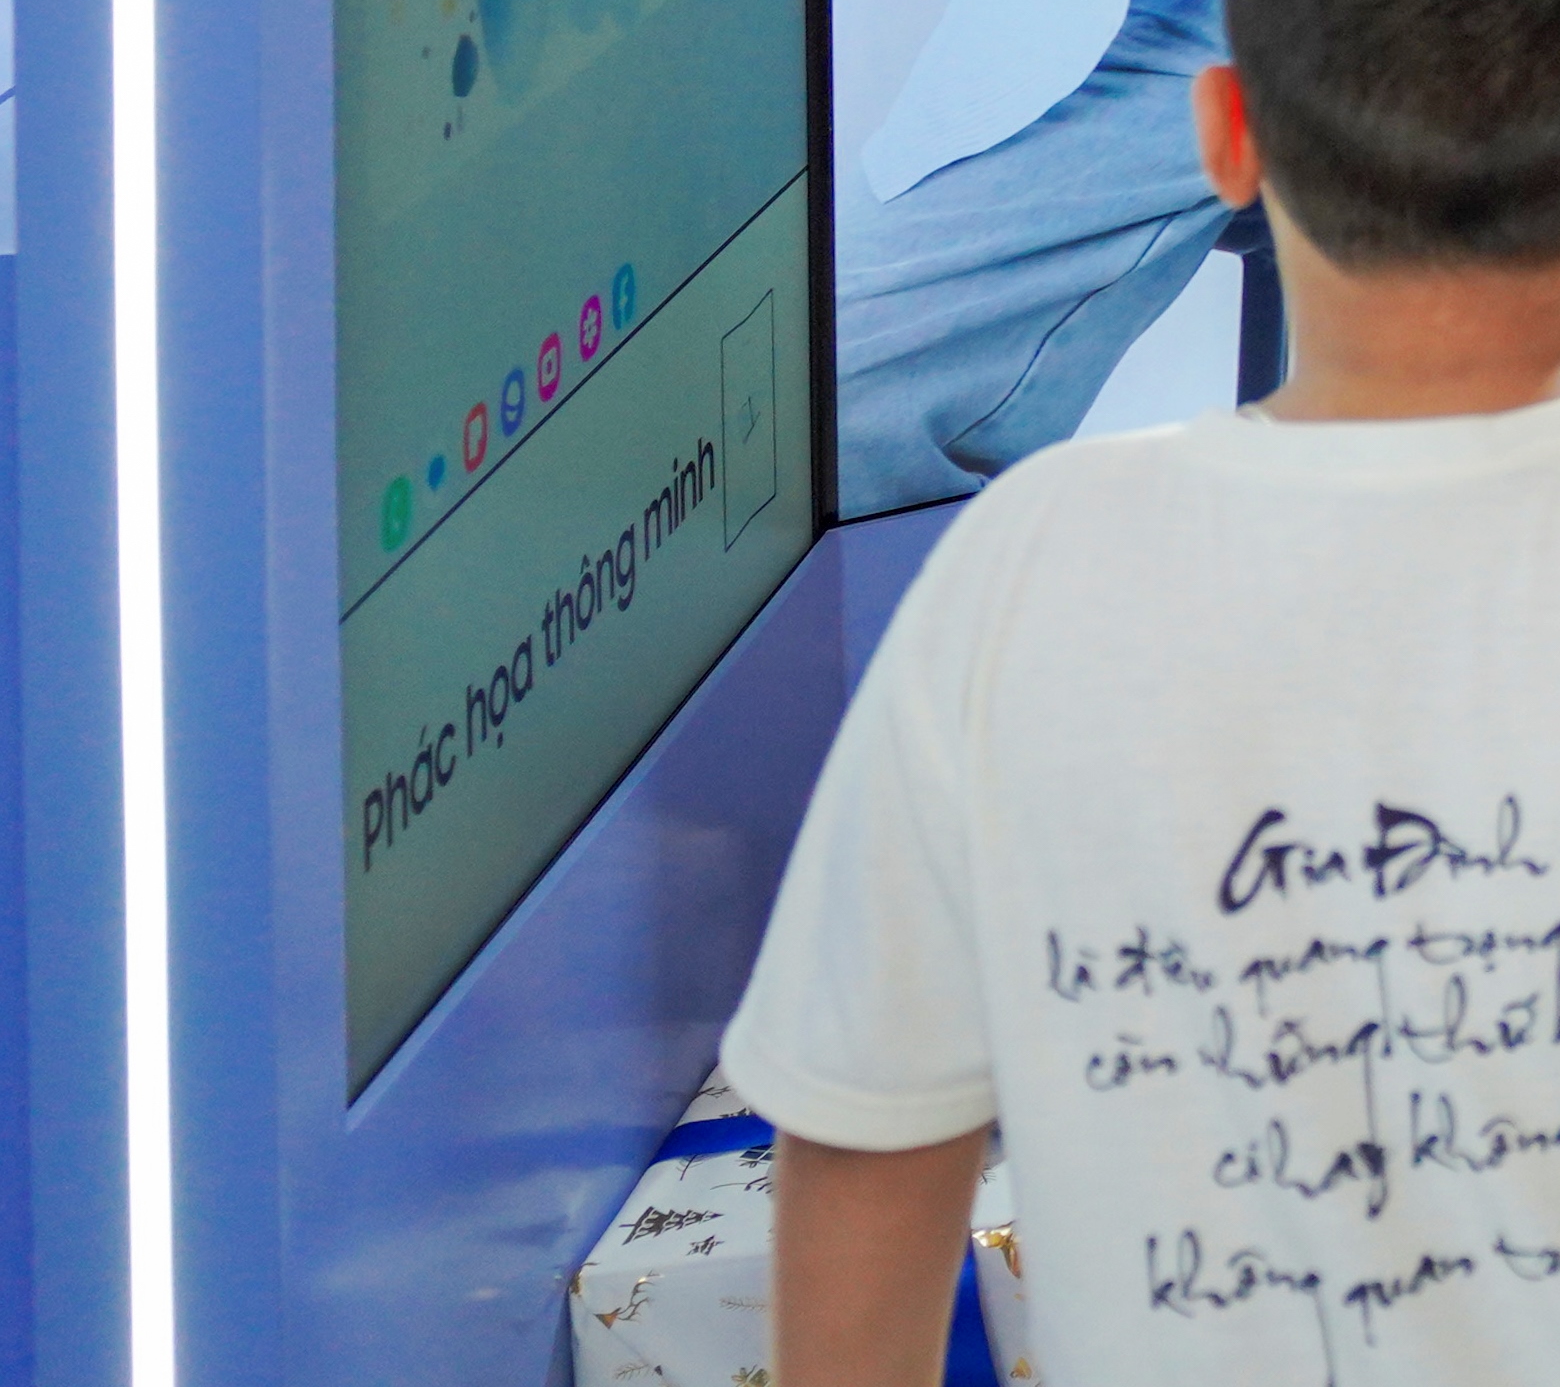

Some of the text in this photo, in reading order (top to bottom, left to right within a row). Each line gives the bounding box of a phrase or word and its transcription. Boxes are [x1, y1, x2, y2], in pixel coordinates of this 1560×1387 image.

[362, 436, 718, 874] Phác họa thông minh
[1216, 808, 1352, 915] Gia
[1146, 1227, 1338, 1387] không
